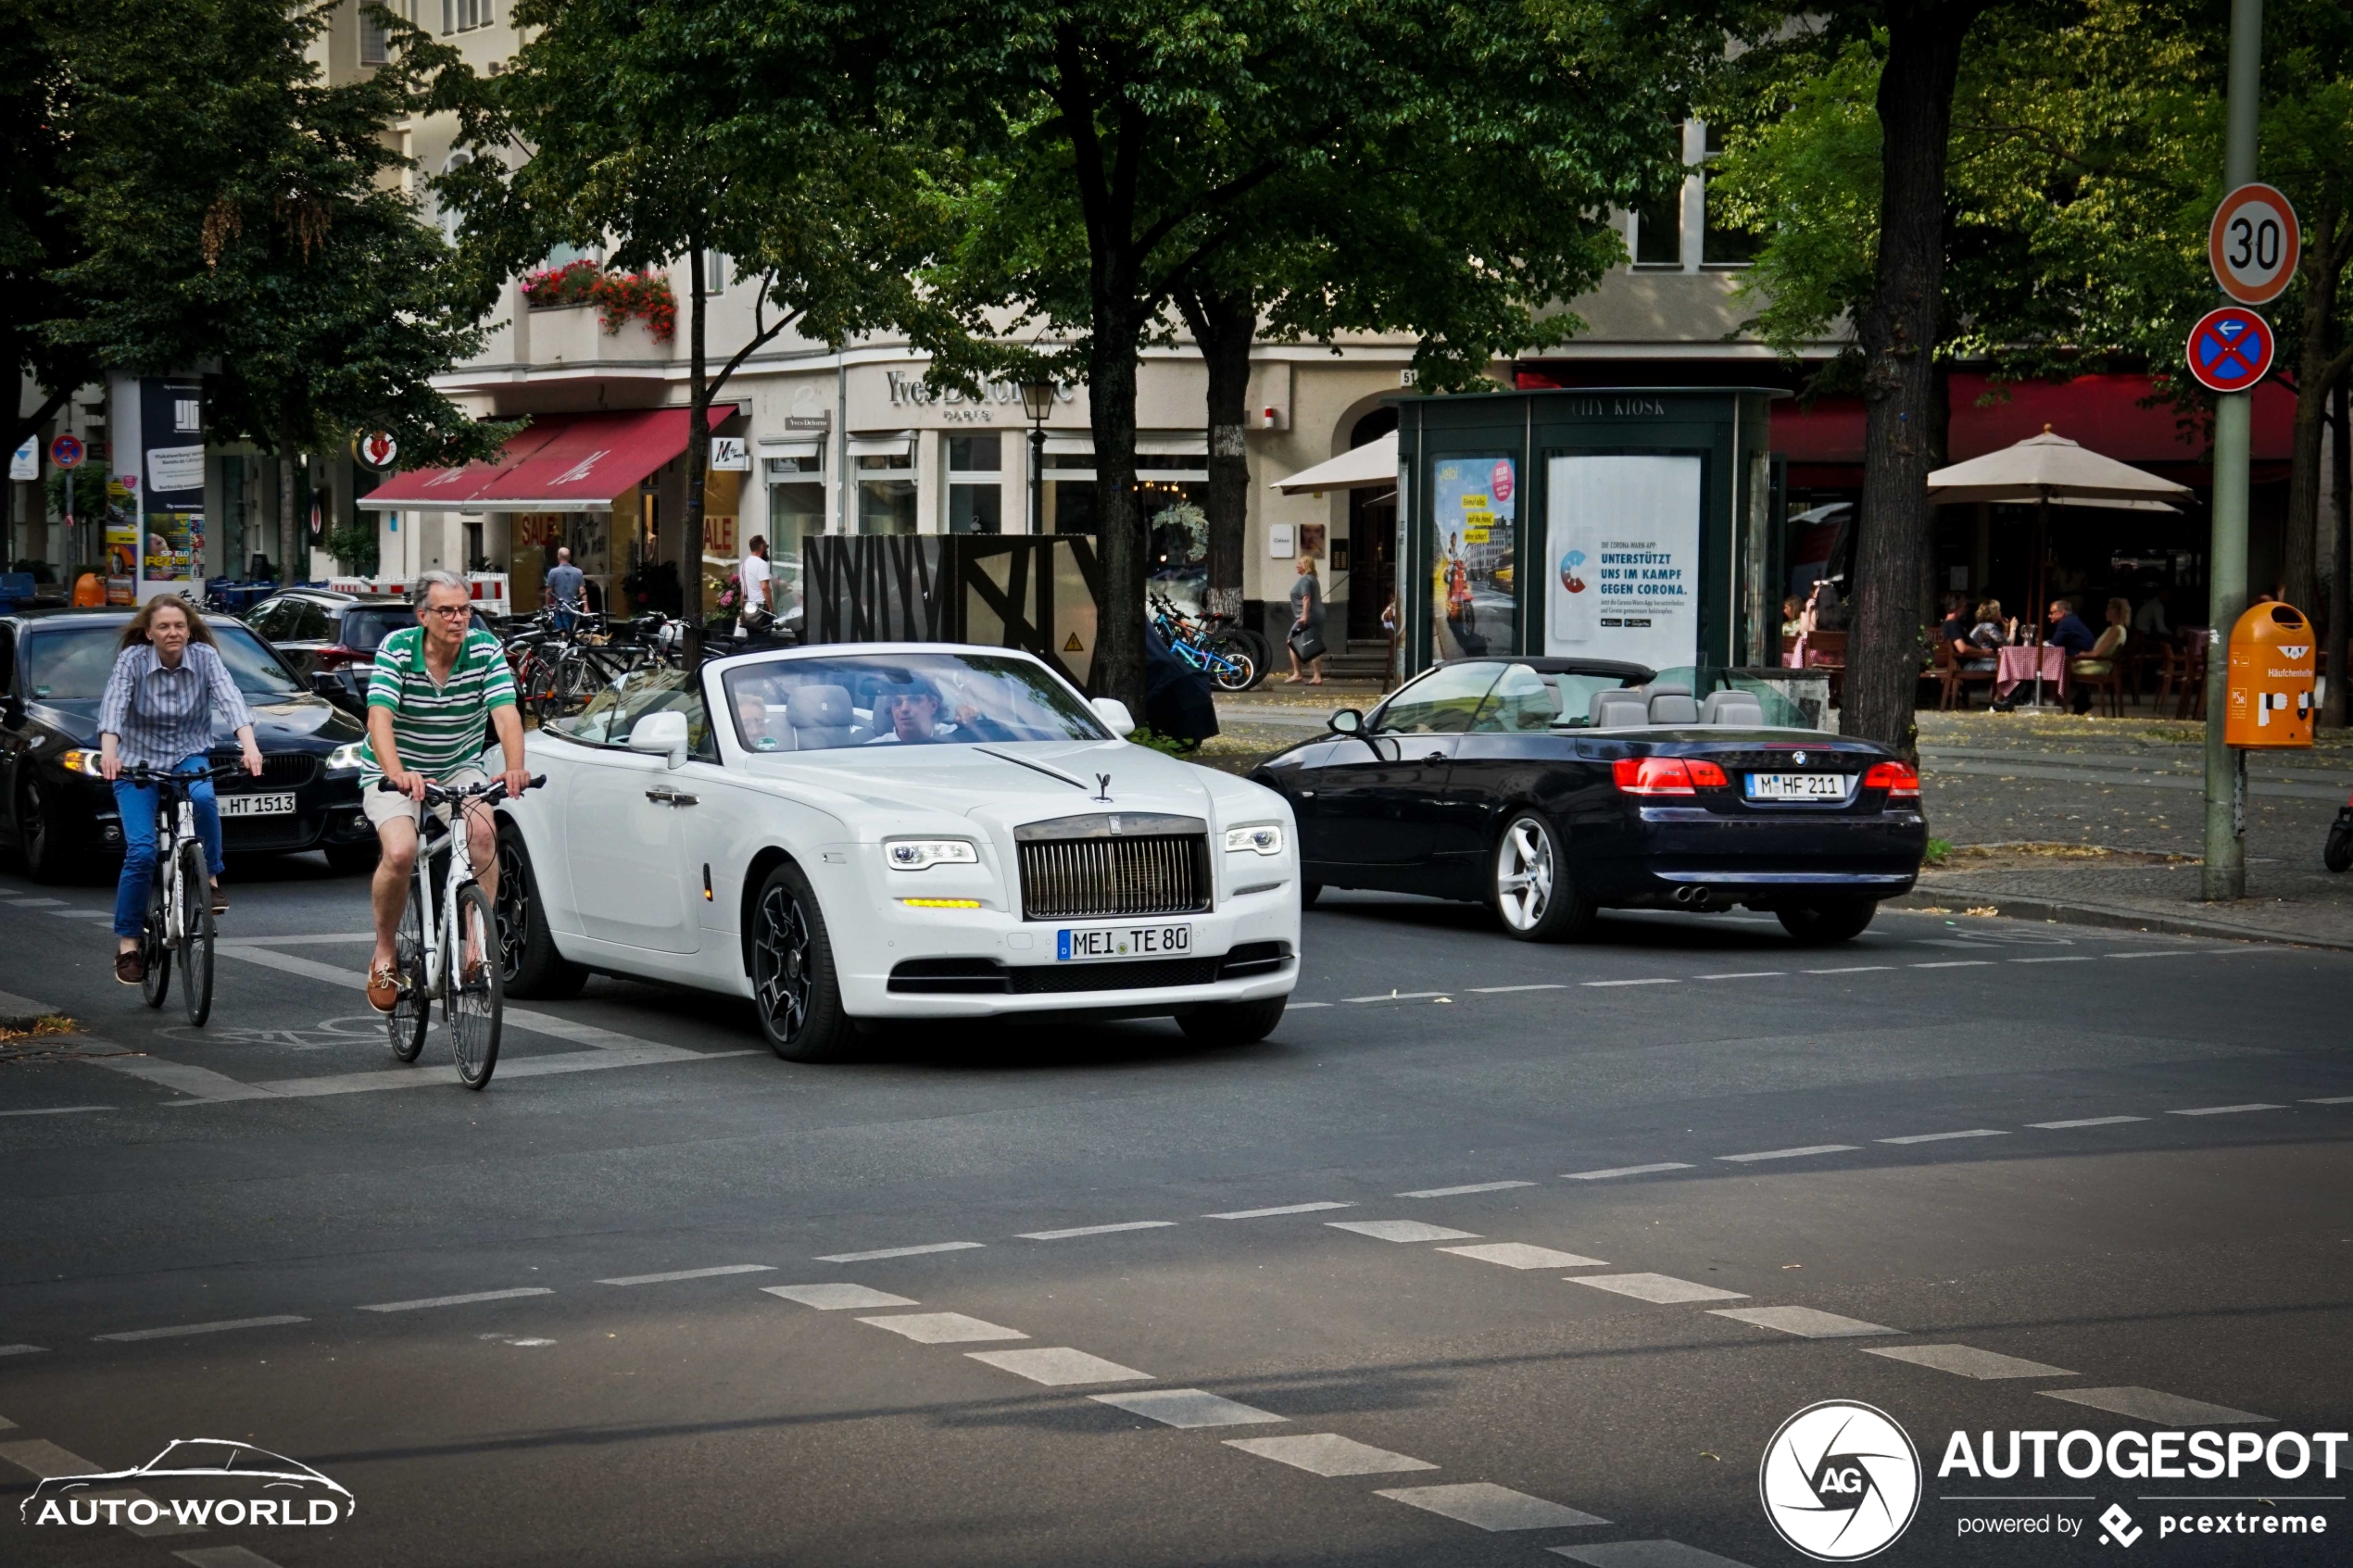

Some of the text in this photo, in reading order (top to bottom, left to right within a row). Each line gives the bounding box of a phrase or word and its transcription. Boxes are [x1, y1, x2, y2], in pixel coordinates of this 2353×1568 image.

[2229, 217, 2280, 270] 30
[1403, 372, 1416, 383] 51
[1572, 398, 1665, 416] CITY KIOSK
[943, 410, 990, 421] PARIS
[715, 440, 732, 462] M
[522, 516, 556, 546] SALE
[704, 518, 731, 550] ALE
[1601, 551, 1672, 564] UNTERSTÜTZT
[1601, 569, 1682, 580] UNS IM KAMPF
[1601, 583, 1688, 595] GEGEN CORONA.
[2268, 668, 2313, 677] Häufchenhelfer
[1761, 777, 1837, 794] M HF 211
[230, 797, 293, 813] HT 1513
[1074, 927, 1188, 955] MEI TE 80
